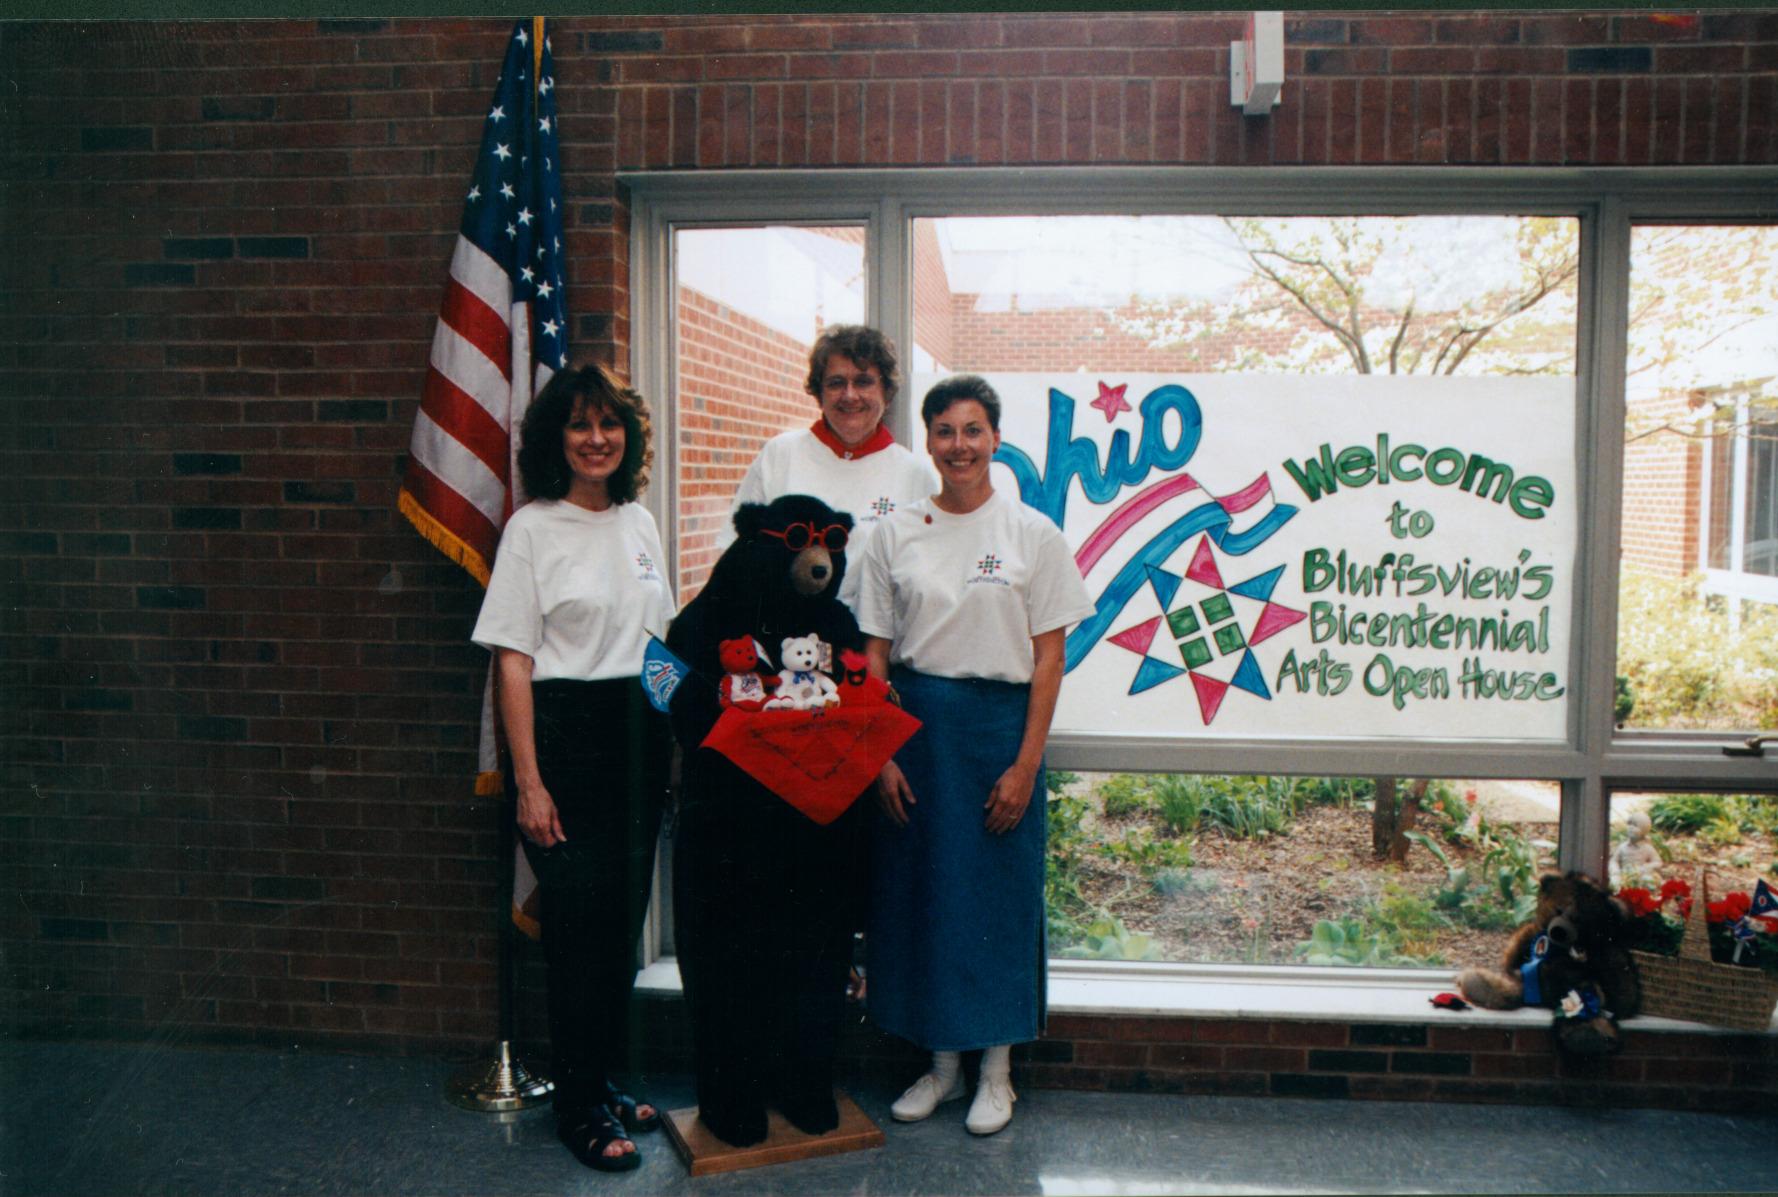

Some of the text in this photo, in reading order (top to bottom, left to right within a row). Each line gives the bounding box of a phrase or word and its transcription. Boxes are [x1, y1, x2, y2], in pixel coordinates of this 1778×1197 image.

[991, 383, 1202, 532] hio
[1282, 432, 1555, 520] Welcome
[1385, 500, 1434, 539] to
[1302, 547, 1554, 600] Bluffsview's
[1309, 600, 1550, 653] Bicentennial
[1276, 648, 1565, 711] Arts Open House
